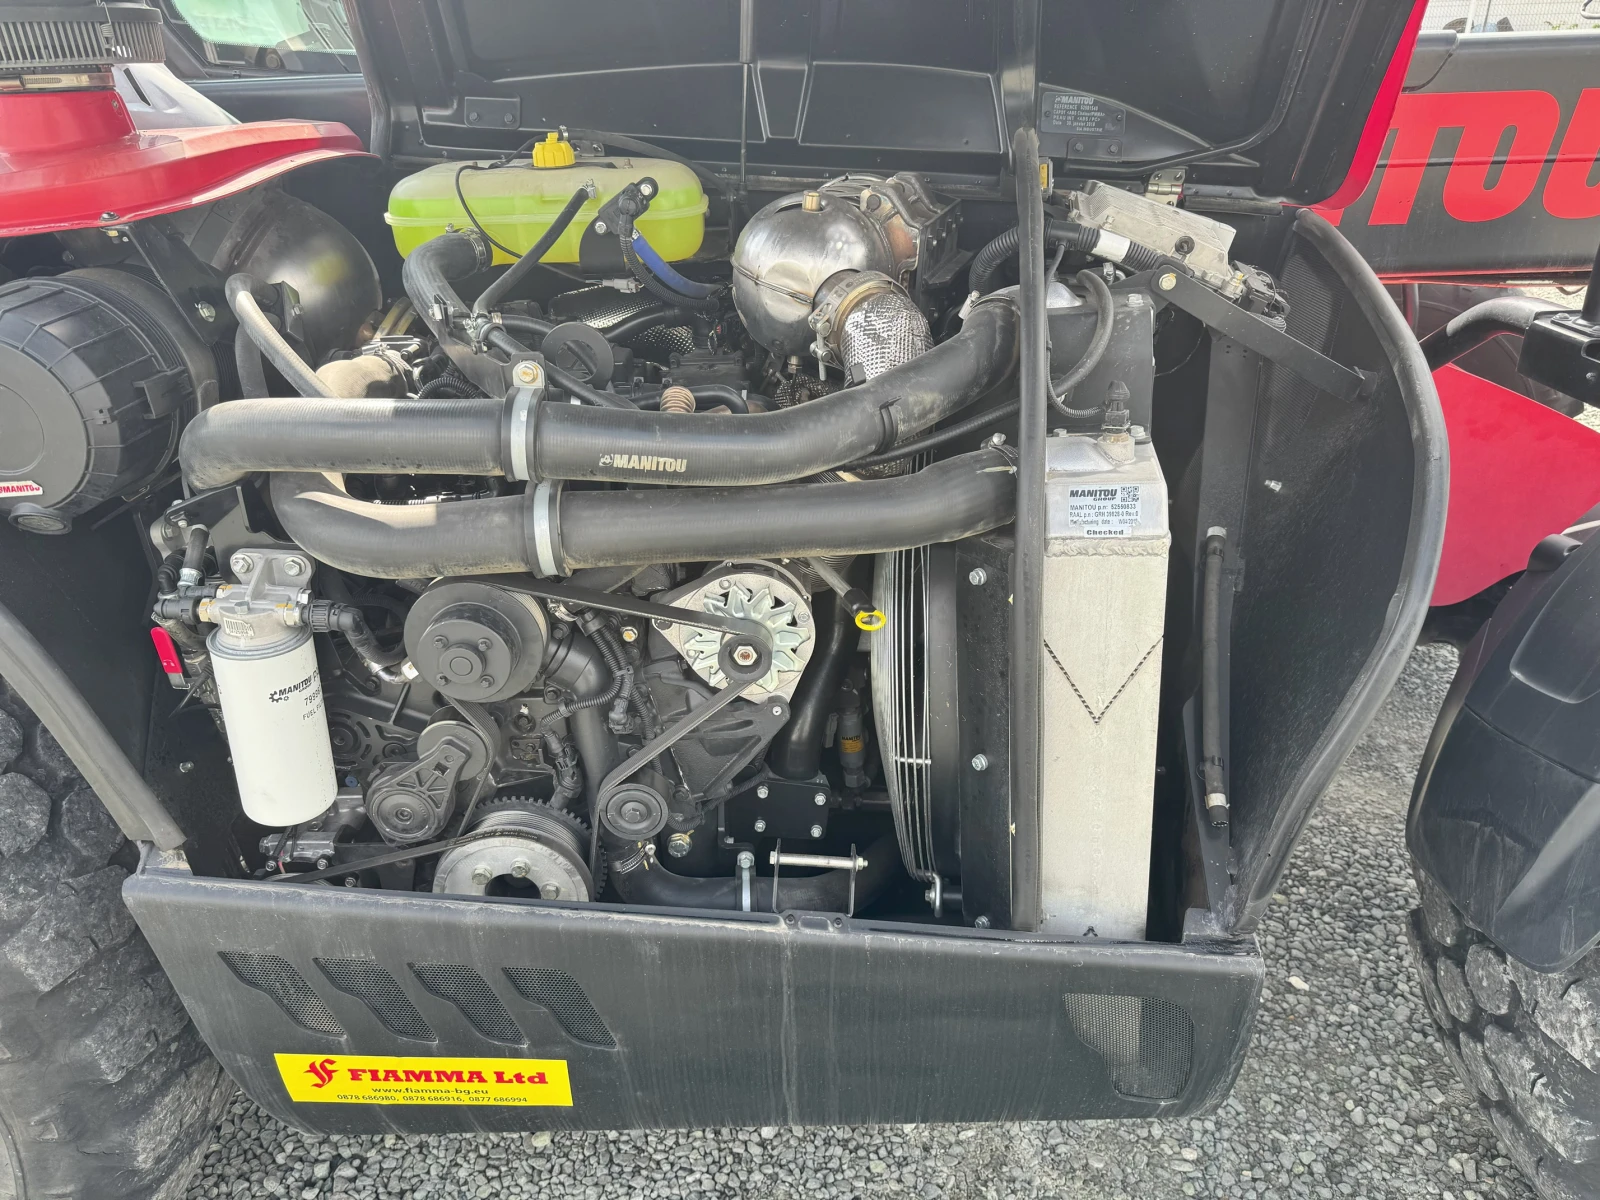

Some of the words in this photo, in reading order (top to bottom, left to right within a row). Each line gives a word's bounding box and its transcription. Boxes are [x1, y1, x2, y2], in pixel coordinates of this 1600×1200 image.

[1061, 96, 1095, 105] MANITOU
[613, 454, 687, 472] MANITOU
[1069, 488, 1118, 498] MANITOU
[278, 675, 312, 696] MANITOU
[348, 1068, 488, 1085] FIAMMA
[493, 1071, 548, 1085] Ltd
[371, 1087, 489, 1096] www.fiamma-bg.eu
[362, 1094, 400, 1102] 686980,
[427, 1095, 466, 1103] 686916,
